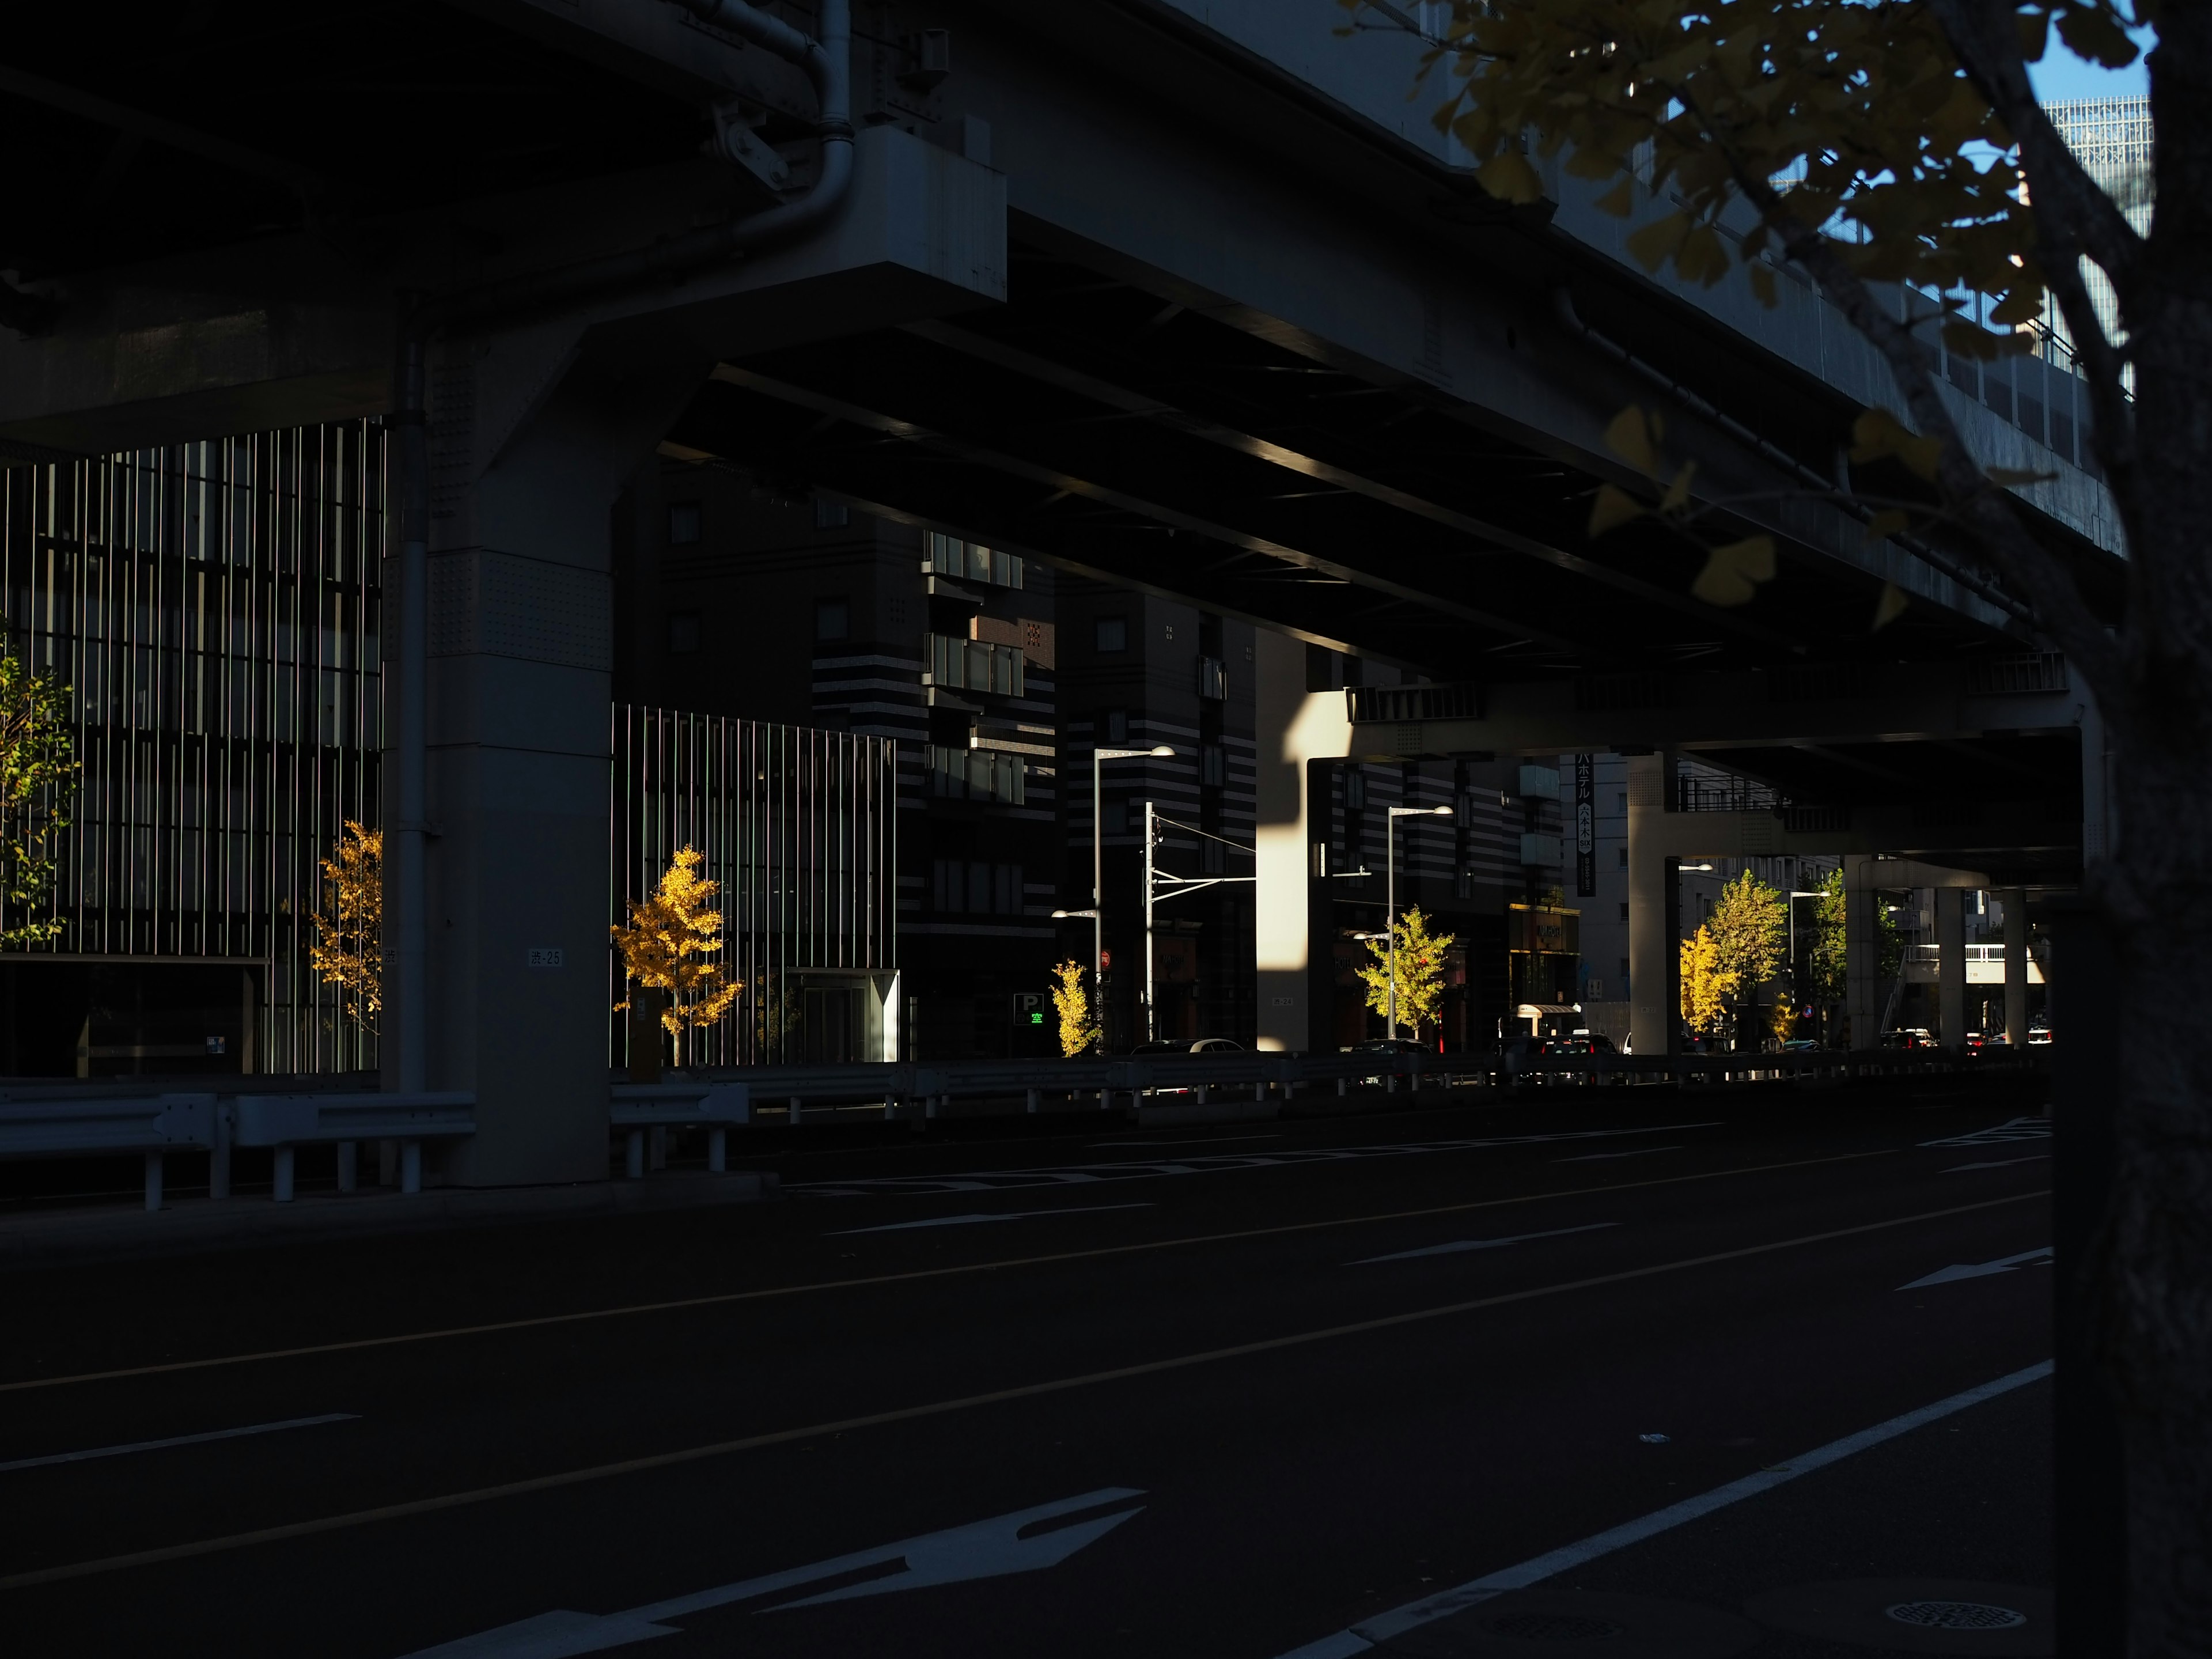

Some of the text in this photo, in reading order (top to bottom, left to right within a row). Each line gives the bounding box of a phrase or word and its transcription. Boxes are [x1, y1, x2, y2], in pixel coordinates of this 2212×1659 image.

[1580, 806, 1590, 838] 六本木
[1548, 926, 1562, 937] HOTEL
[532, 950, 559, 964] 渋-25
[1023, 995, 1038, 1011] P
[1031, 1013, 1043, 1024] 空
